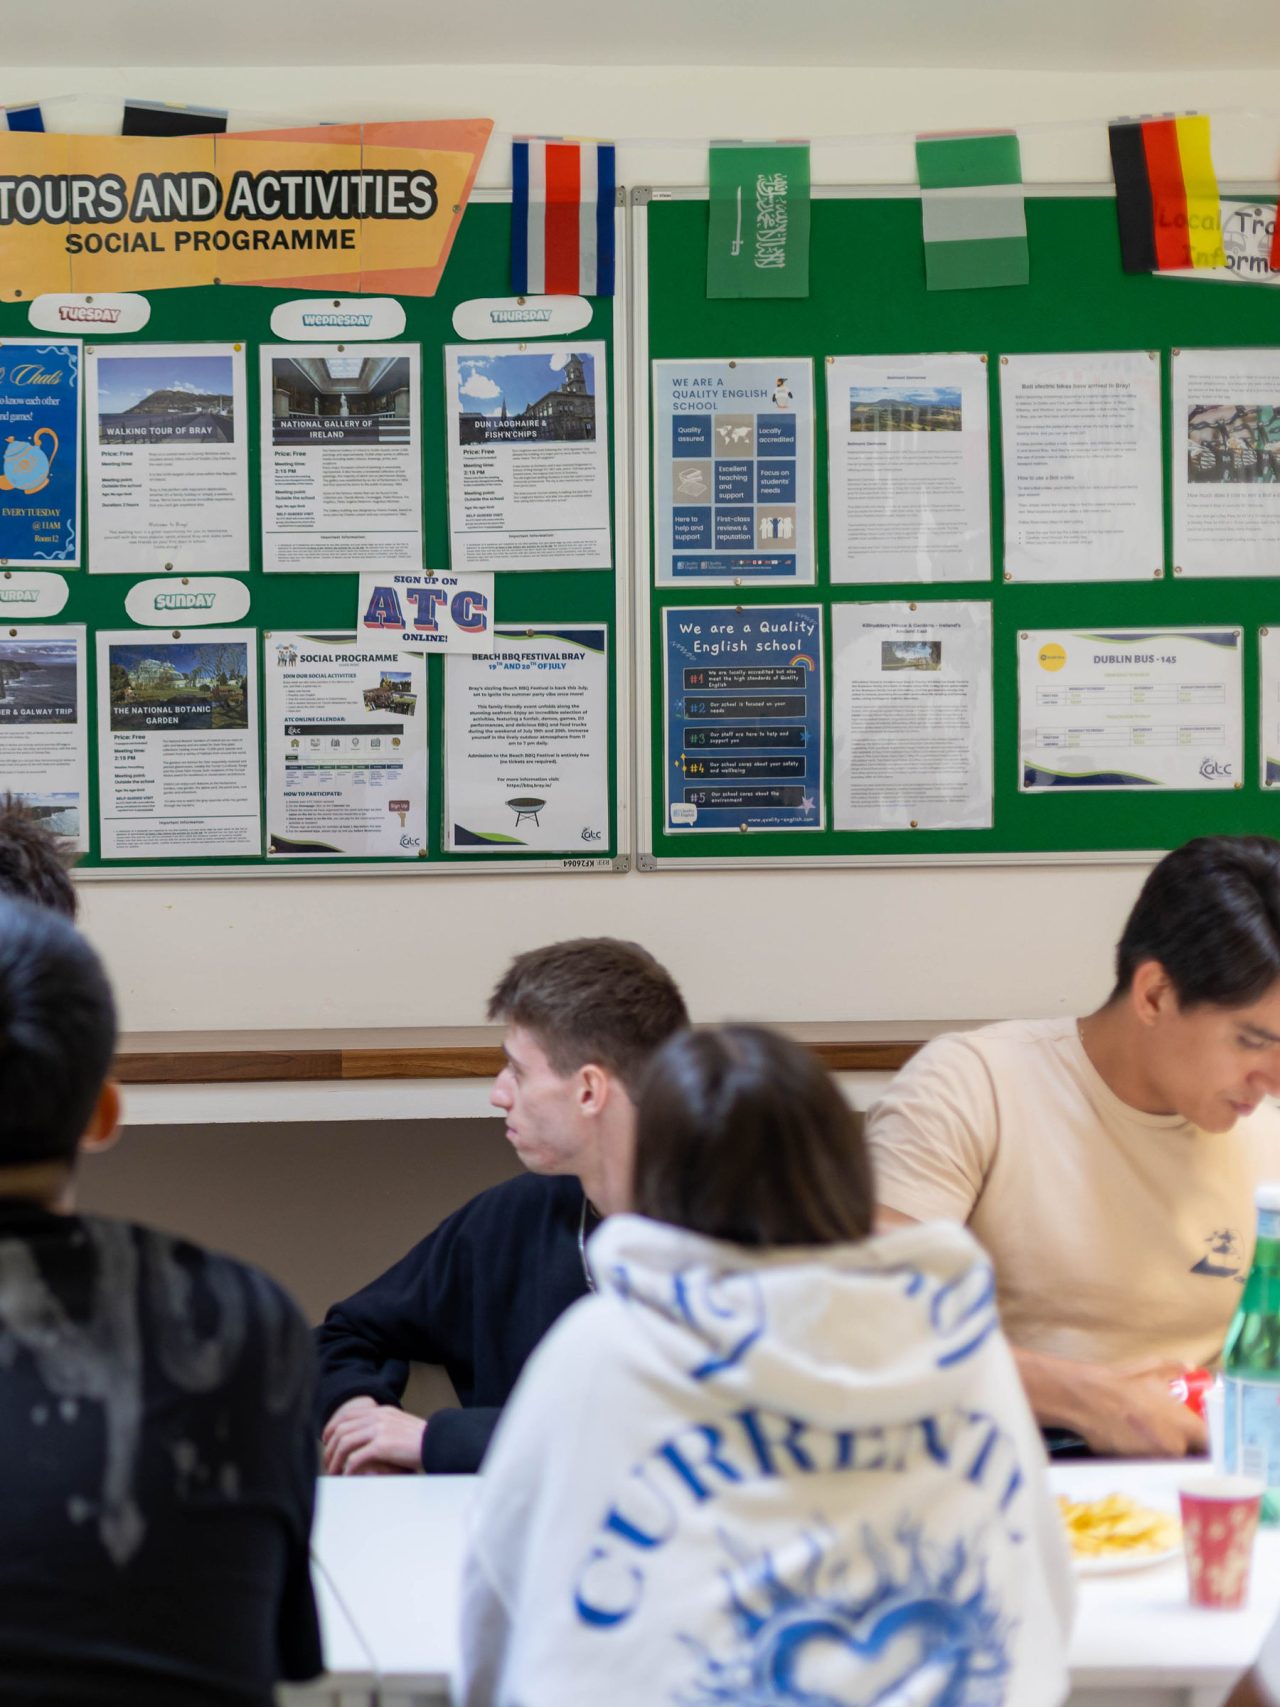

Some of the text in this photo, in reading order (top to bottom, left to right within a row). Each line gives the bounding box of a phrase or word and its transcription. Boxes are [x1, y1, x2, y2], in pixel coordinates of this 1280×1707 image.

[133, 174, 219, 220] AND
[228, 173, 435, 218] ACTIVITIES
[65, 229, 355, 254] SOCIAL PROGRAMME
[490, 309, 552, 323] THURSDAY
[672, 378, 724, 387] WE ARE A
[672, 389, 768, 399] QUALITY ENGLISH
[41, 396, 60, 405] other
[672, 402, 718, 411] SCHOOL
[9, 412, 33, 422] games!
[494, 420, 540, 428] LAOGHAIRE
[106, 426, 212, 435] WALKING TOUR OF BRAY
[678, 426, 701, 434] Quality
[759, 427, 782, 436] Locally
[485, 431, 537, 439] FISH'N'CHIPS
[719, 474, 748, 482] teaching
[719, 492, 744, 500] support
[2, 508, 60, 516] EVERY TUESDAY
[675, 524, 689, 533] help
[675, 533, 701, 541] support
[717, 533, 751, 541] reputation
[393, 575, 458, 586] SIGN UP ON
[363, 586, 488, 634] ATC
[679, 623, 702, 634] We
[710, 625, 734, 634] are
[759, 621, 815, 637] Quality
[402, 632, 448, 643] ONLINE!
[693, 639, 802, 655] English school
[299, 654, 399, 663] SOCIAL PROGRAMME
[502, 653, 520, 661] BBQ
[1093, 654, 1177, 664] DUBLIN BUS 145
[132, 706, 173, 714] NATIONAL
[175, 705, 211, 713] BOTANIC
[146, 717, 179, 725] GARDEN
[690, 762, 705, 774] #4
[690, 792, 706, 803] #5
